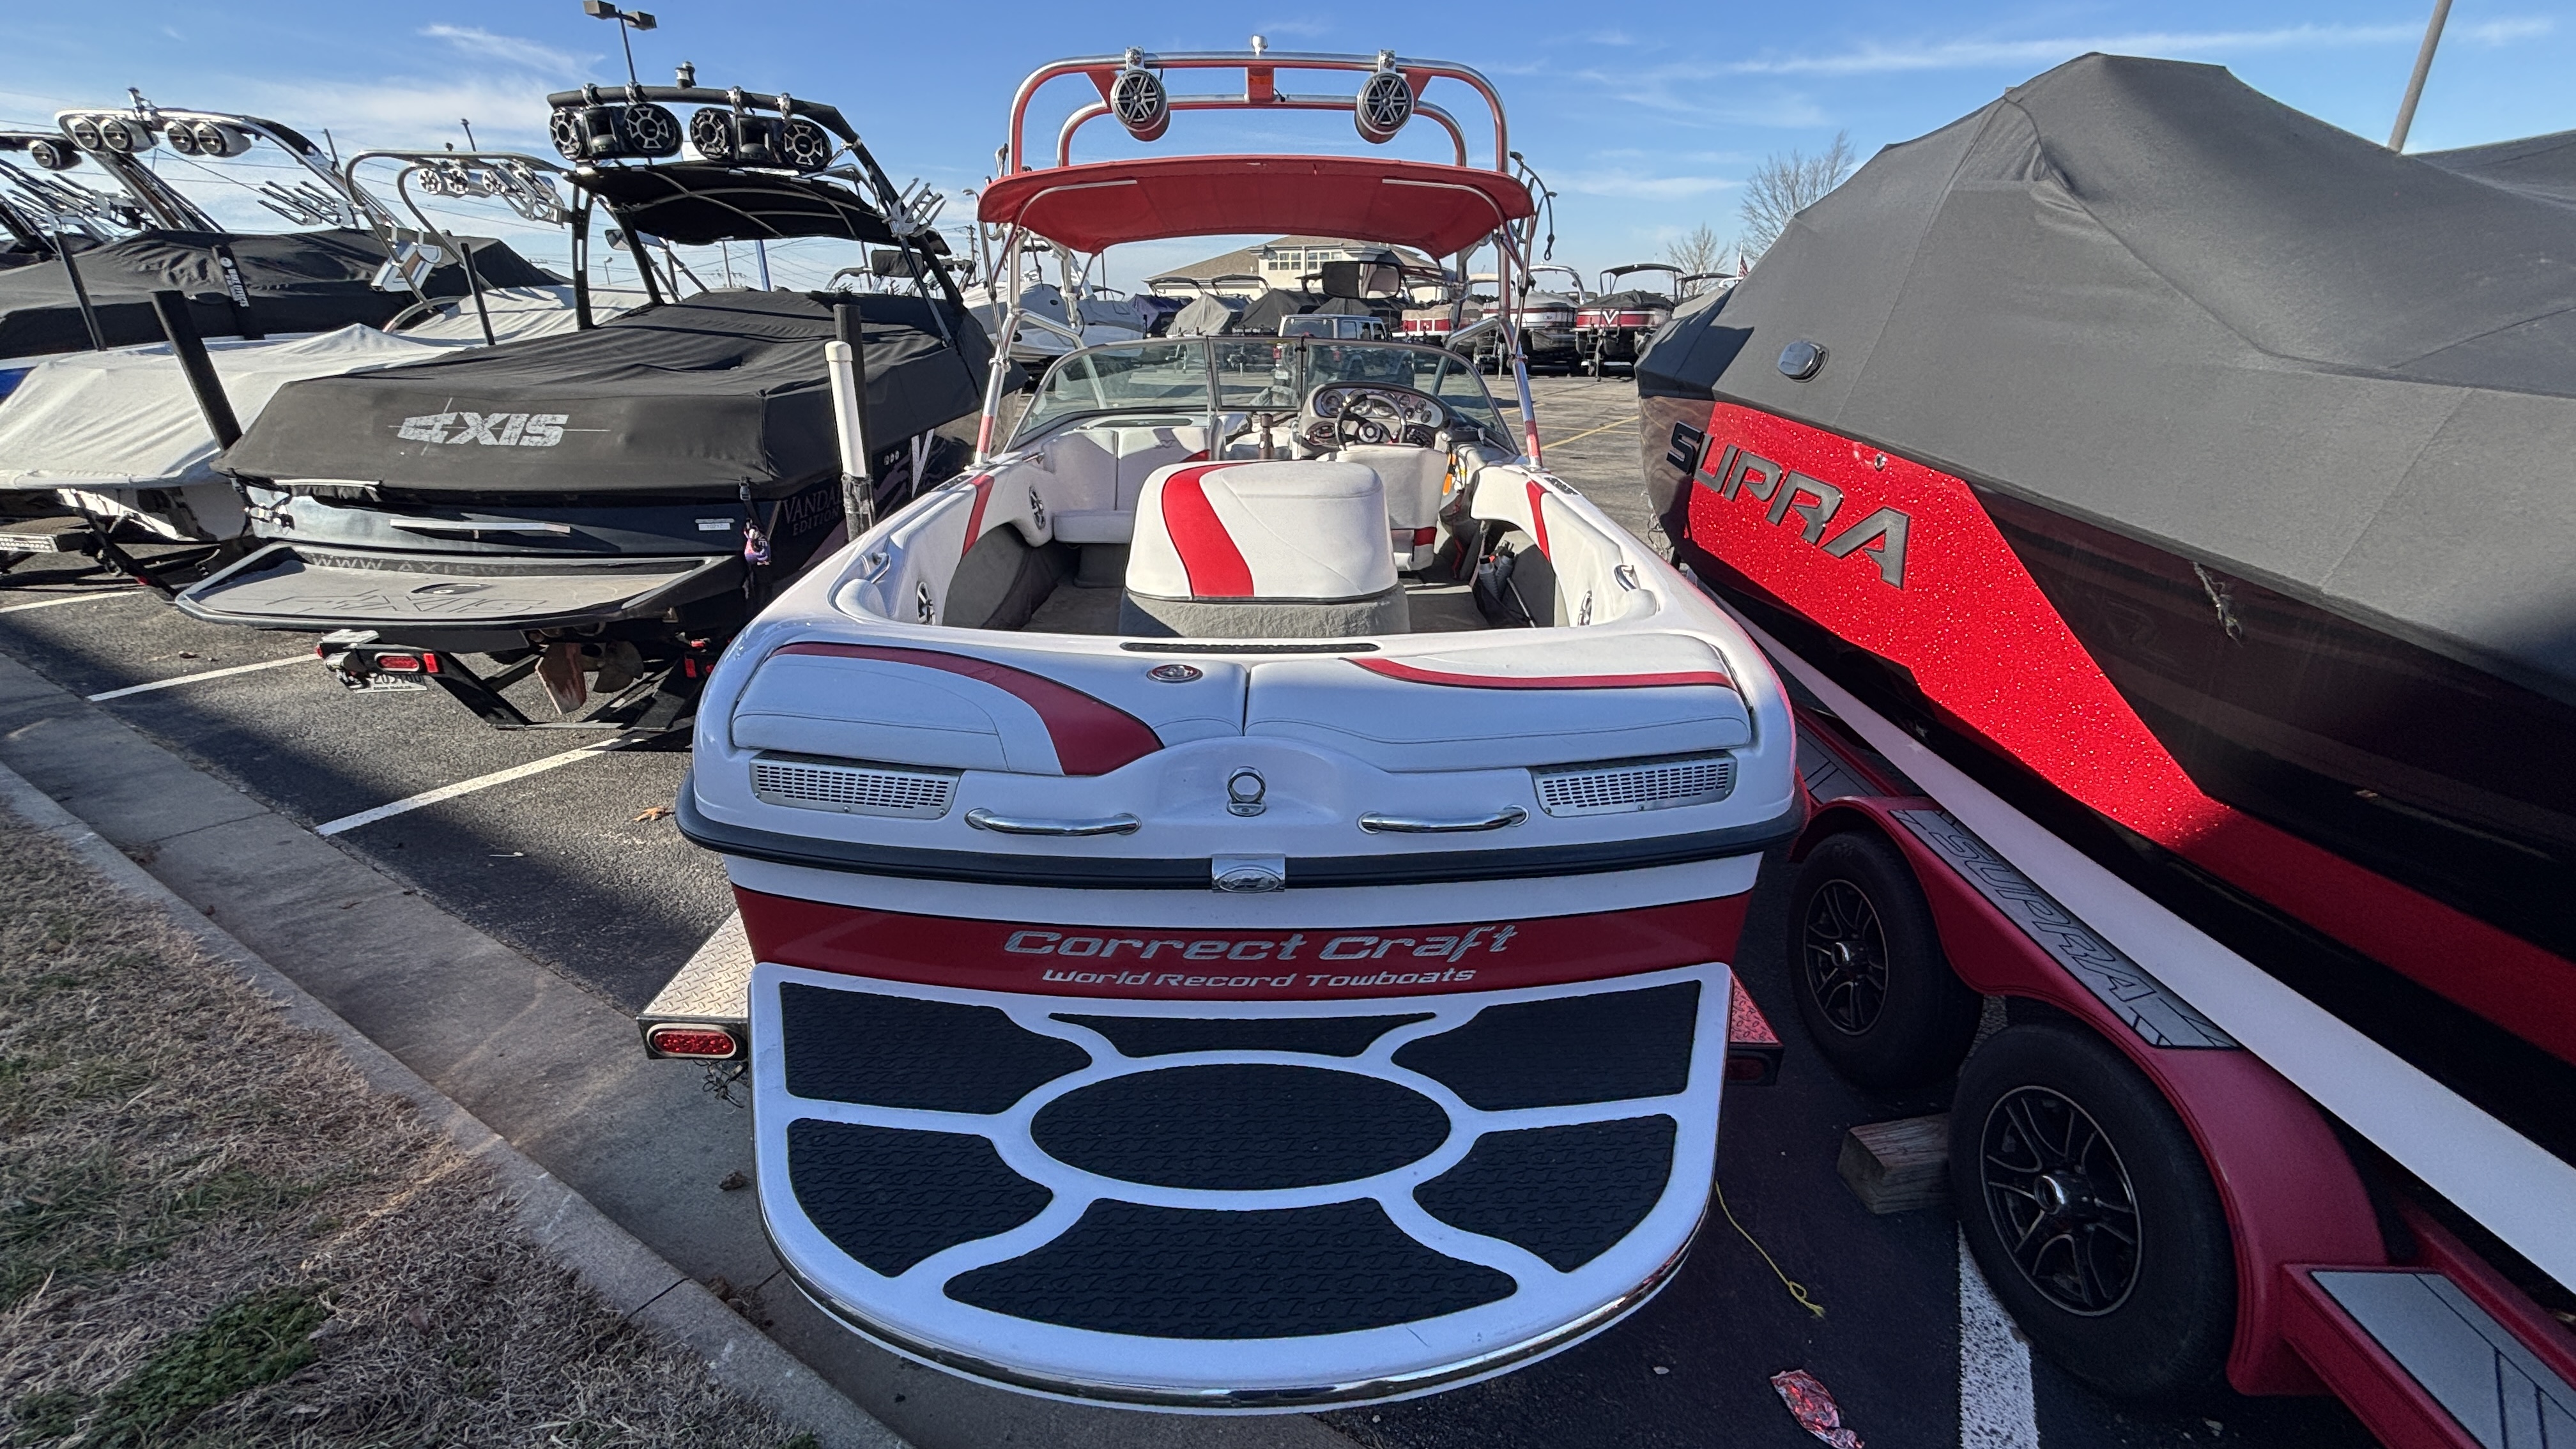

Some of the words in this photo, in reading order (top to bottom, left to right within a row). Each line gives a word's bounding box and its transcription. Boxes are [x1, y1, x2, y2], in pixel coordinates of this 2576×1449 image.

[397, 411, 569, 447] AXIS
[792, 505, 839, 537] EDITION
[1666, 420, 1910, 590] SUPRA
[1929, 831, 2157, 1002] SUPRA
[1004, 930, 1307, 960] Correct
[1319, 924, 1519, 963] Craft
[1041, 969, 1151, 985] World
[1154, 972, 1298, 987] Record
[1305, 967, 1476, 986] Towboats
